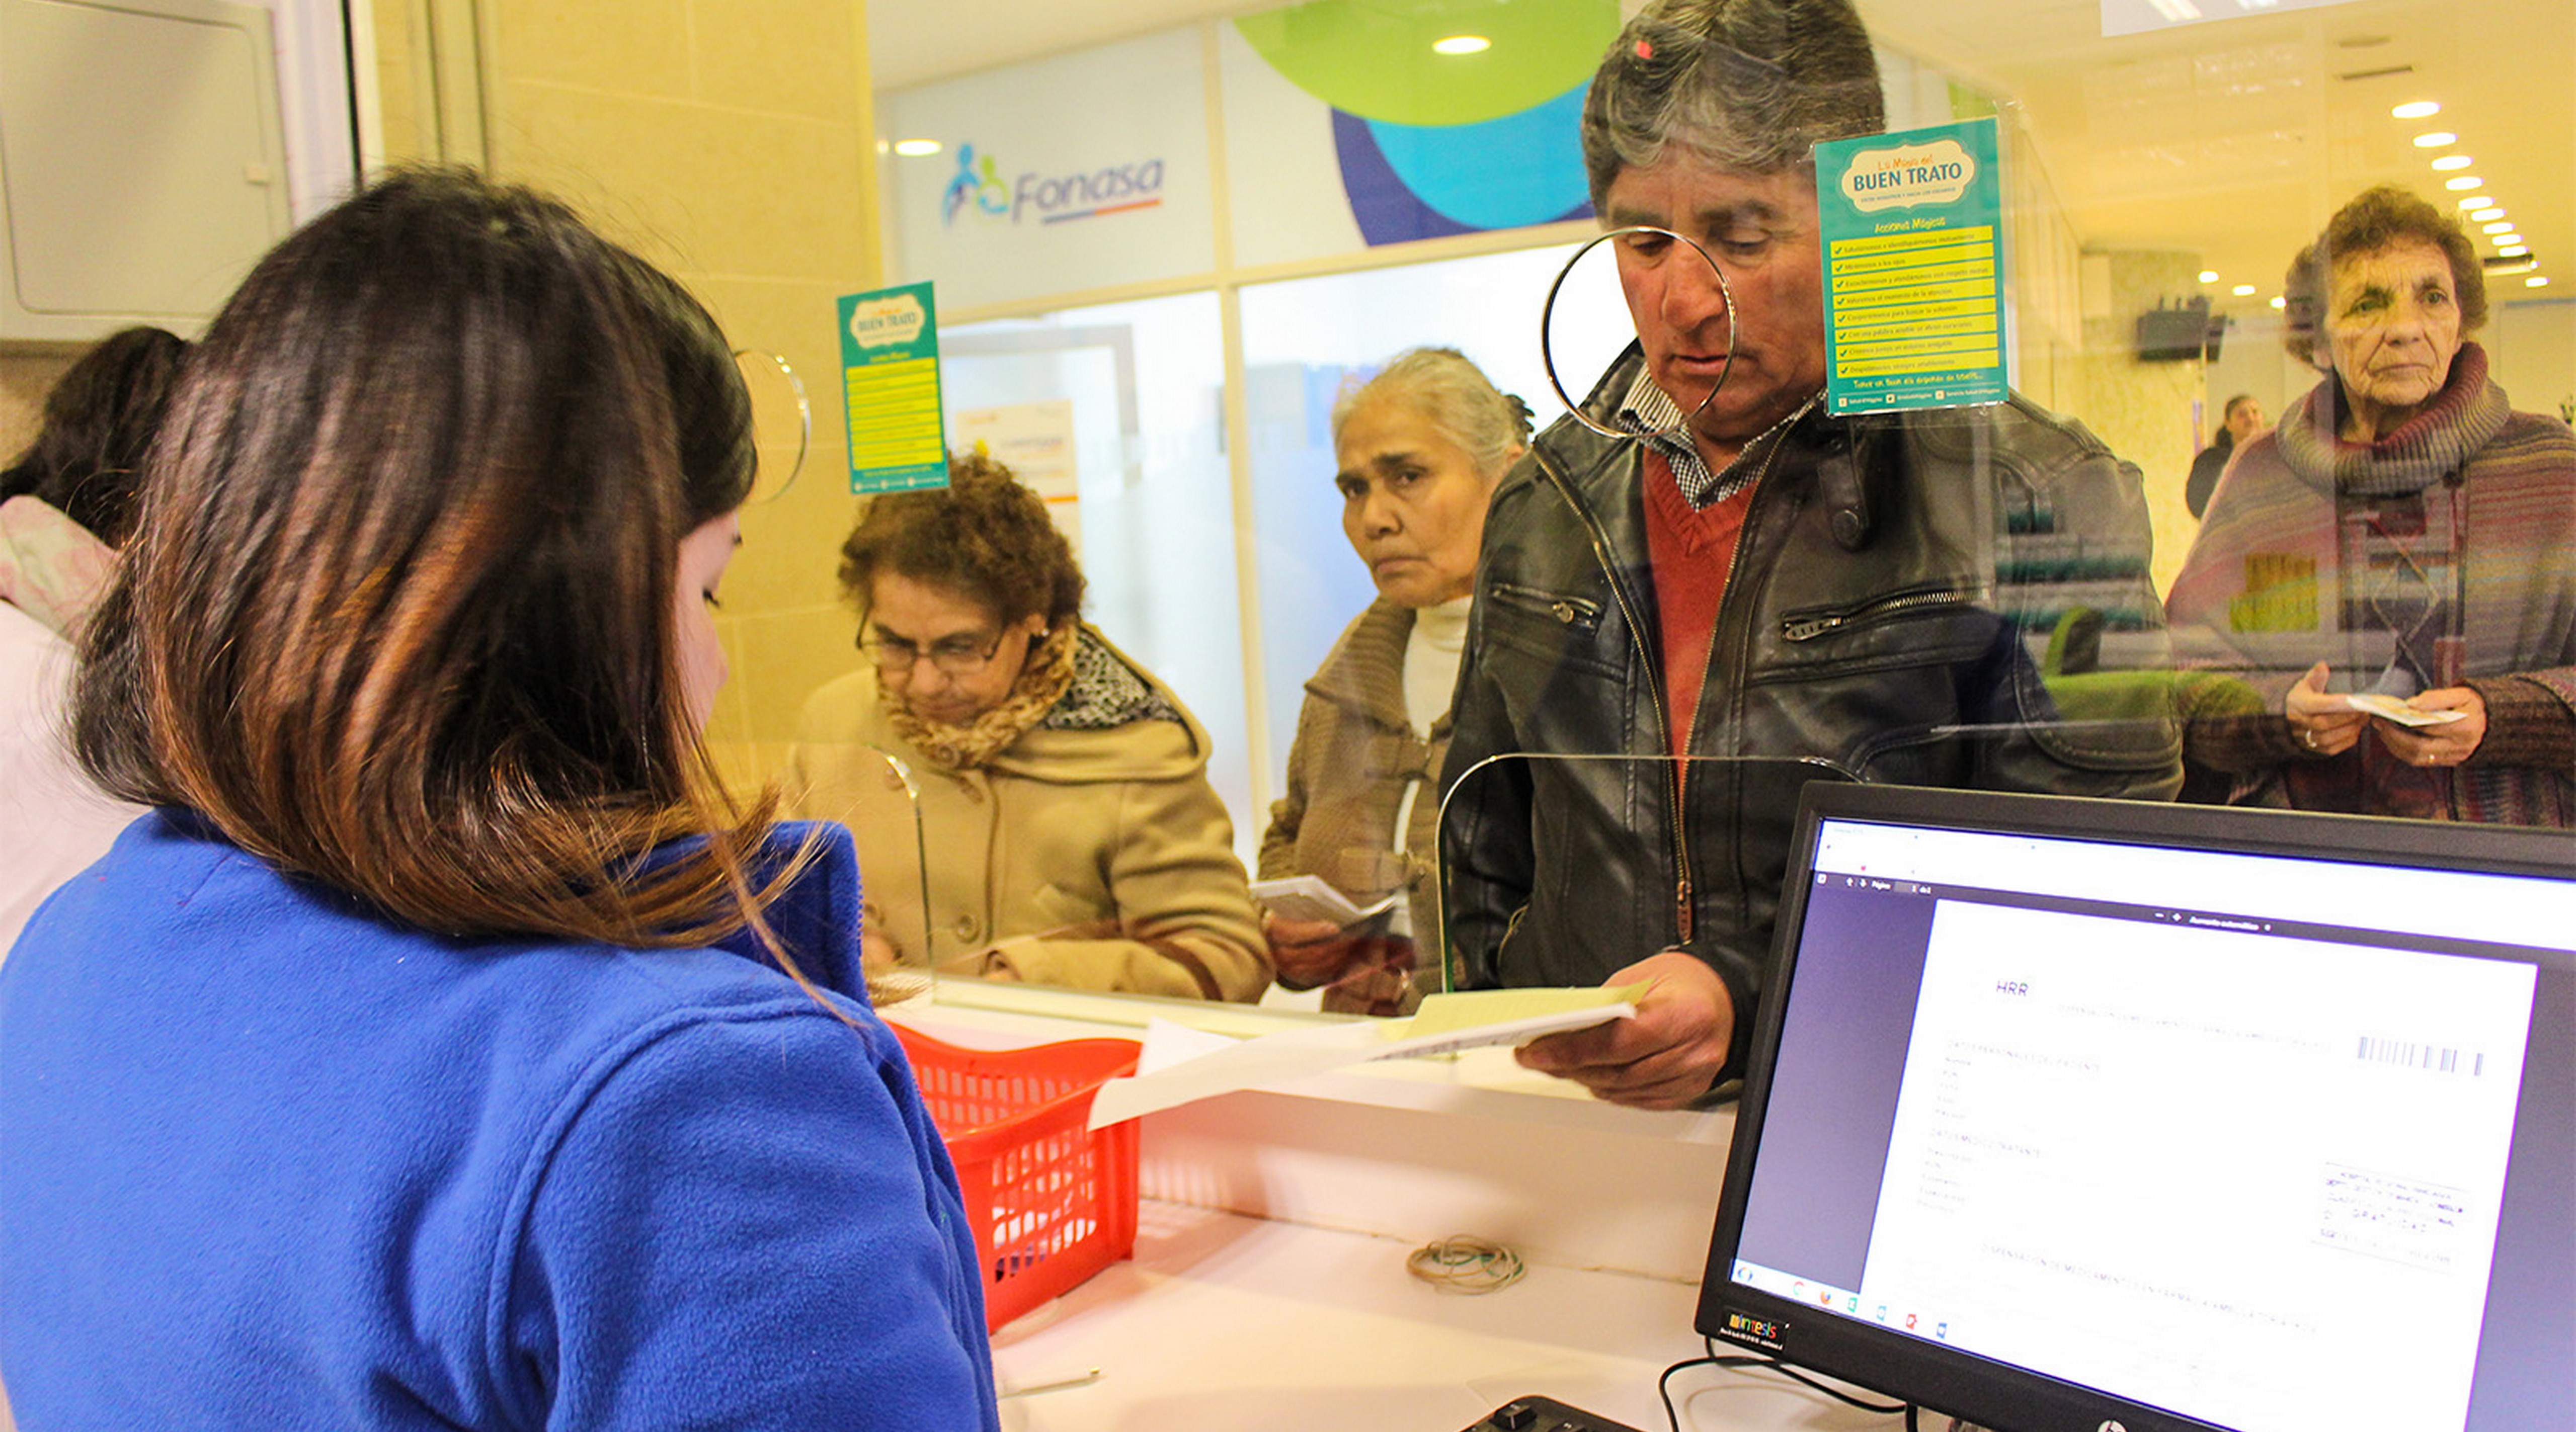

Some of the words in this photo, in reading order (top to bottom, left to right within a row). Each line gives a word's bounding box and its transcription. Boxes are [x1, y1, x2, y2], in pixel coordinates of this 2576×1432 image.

[1012, 158, 1163, 224] Fonasa
[1854, 171, 1901, 191] BUEN
[1906, 162, 1962, 184] TRATO
[1996, 980, 2029, 996] HRR
